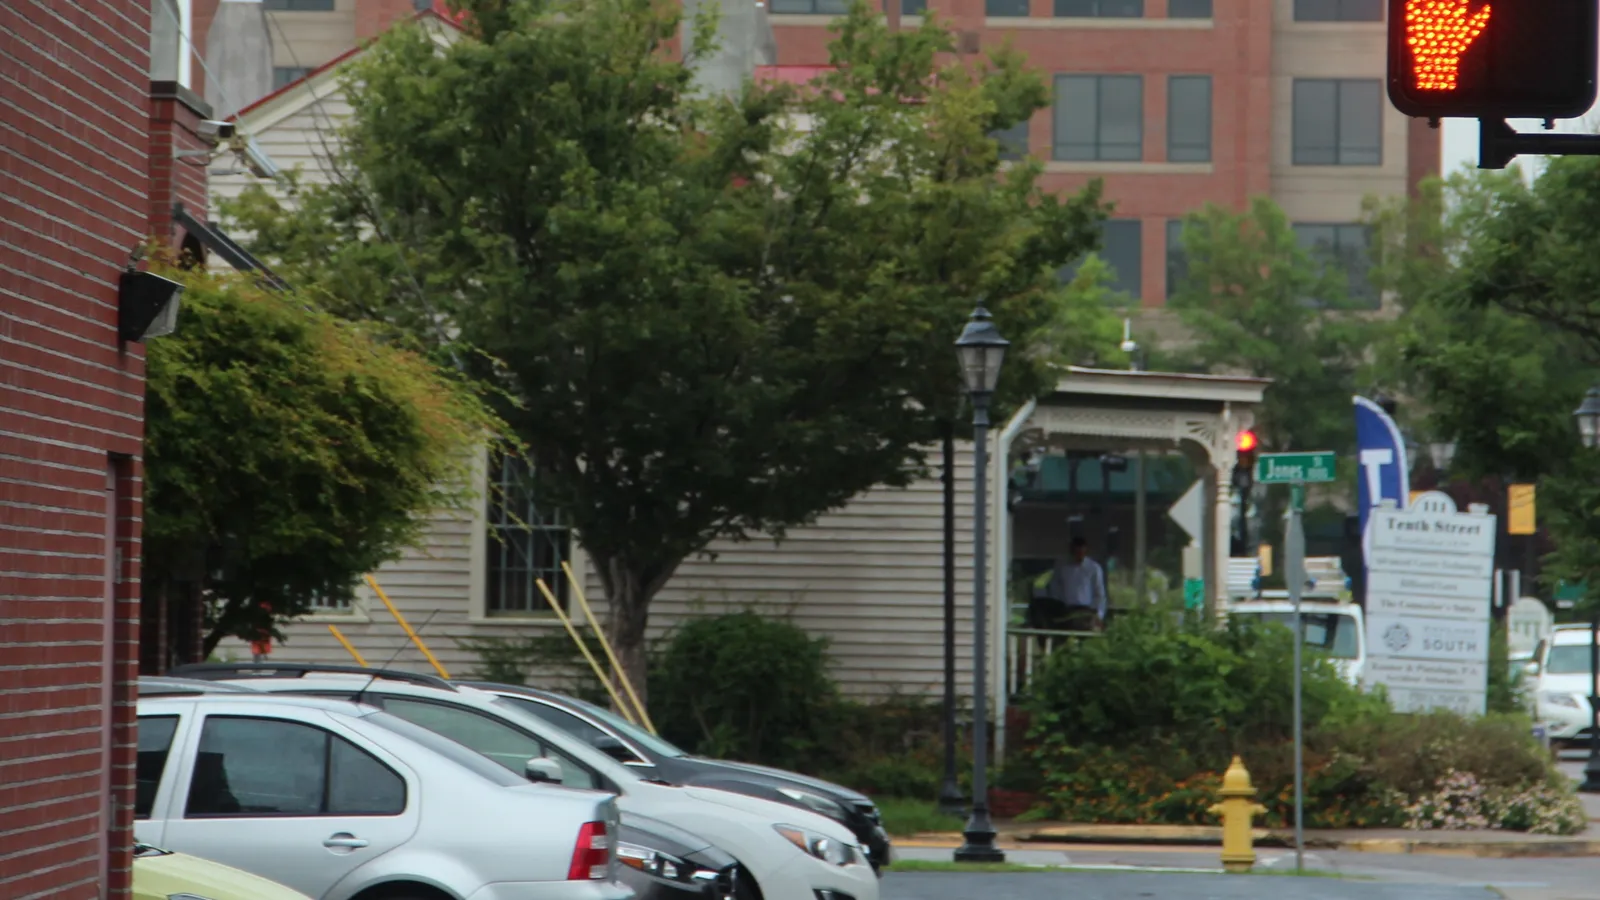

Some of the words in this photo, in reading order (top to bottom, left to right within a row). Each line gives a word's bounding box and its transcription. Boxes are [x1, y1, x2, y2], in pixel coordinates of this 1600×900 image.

[1266, 458, 1304, 479] Jones
[1423, 501, 1447, 513] 111
[1387, 517, 1431, 532] Tenth
[1434, 520, 1482, 535] Street
[1422, 639, 1478, 653] SOUTH
